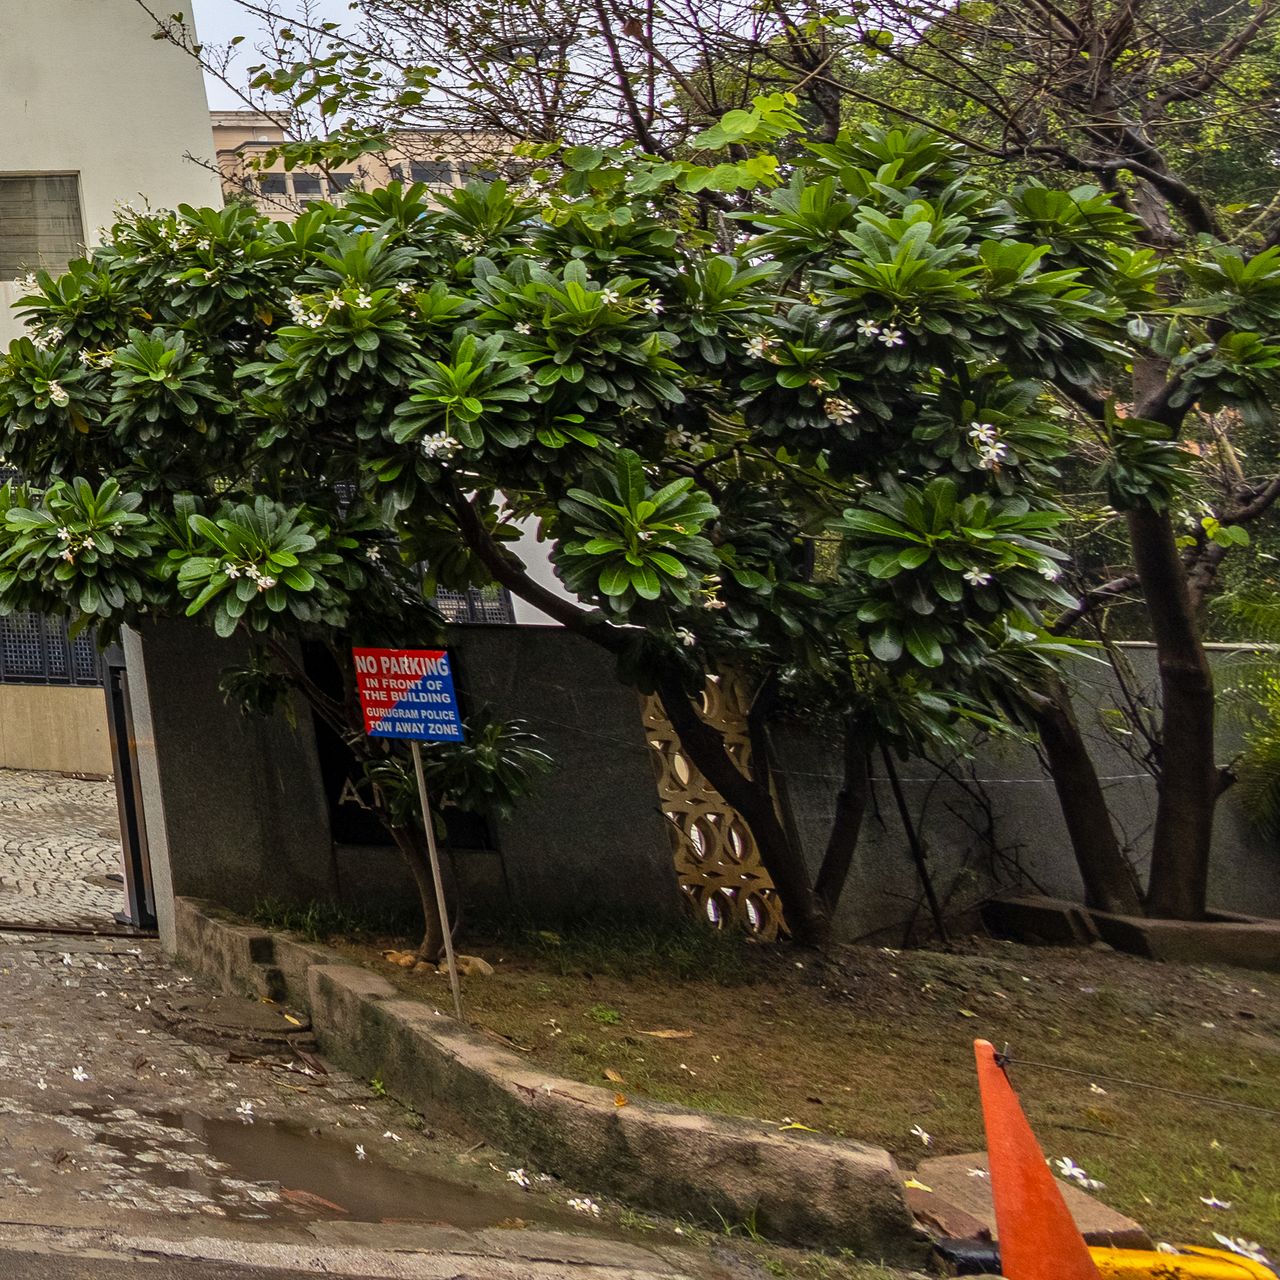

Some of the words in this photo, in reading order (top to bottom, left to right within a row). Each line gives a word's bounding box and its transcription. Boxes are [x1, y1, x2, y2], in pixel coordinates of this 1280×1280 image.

[354, 655, 378, 674] NO
[380, 655, 449, 676] PARKING
[365, 678, 379, 689] IN
[382, 678, 423, 690] FRONT
[426, 680, 444, 691] OF
[362, 690, 388, 701] THE
[391, 691, 451, 703] BUILDING
[366, 707, 419, 719] GURUGRAM
[421, 709, 456, 721] POLICE
[369, 720, 393, 733] TOW
[393, 722, 426, 734] AWAY
[428, 723, 459, 736] ZONE
